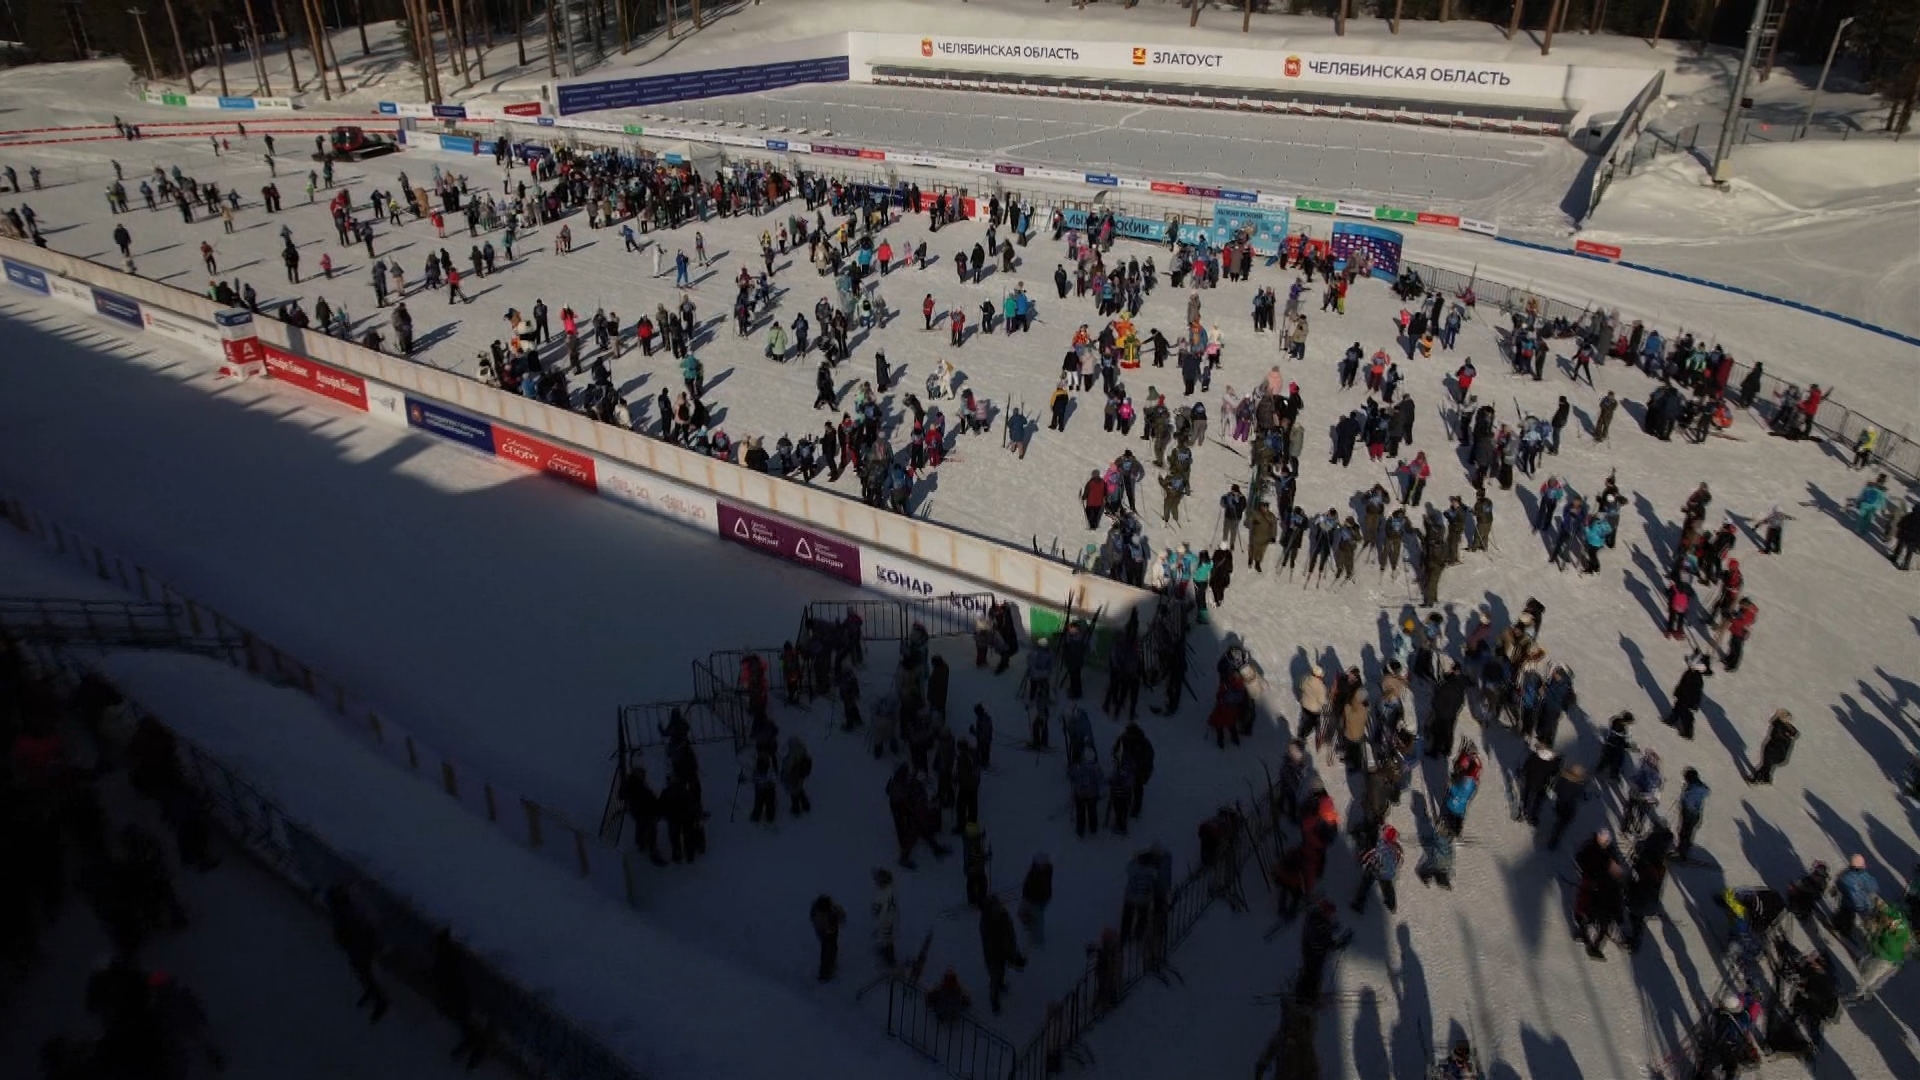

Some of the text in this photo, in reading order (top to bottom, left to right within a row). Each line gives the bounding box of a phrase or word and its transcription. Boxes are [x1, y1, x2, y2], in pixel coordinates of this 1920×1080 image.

[938, 42, 1079, 60] ЧЕЛЯБИНСКАЯ ОБЛАСТЬ
[1153, 52, 1223, 67] ЗЛАТОУСТ
[1308, 61, 1511, 86] ЧЕЛЯБИНСКАЯ ОБЛАСТЬ
[1115, 216, 1150, 234] ОССИИ
[876, 565, 933, 595] КОНАР
